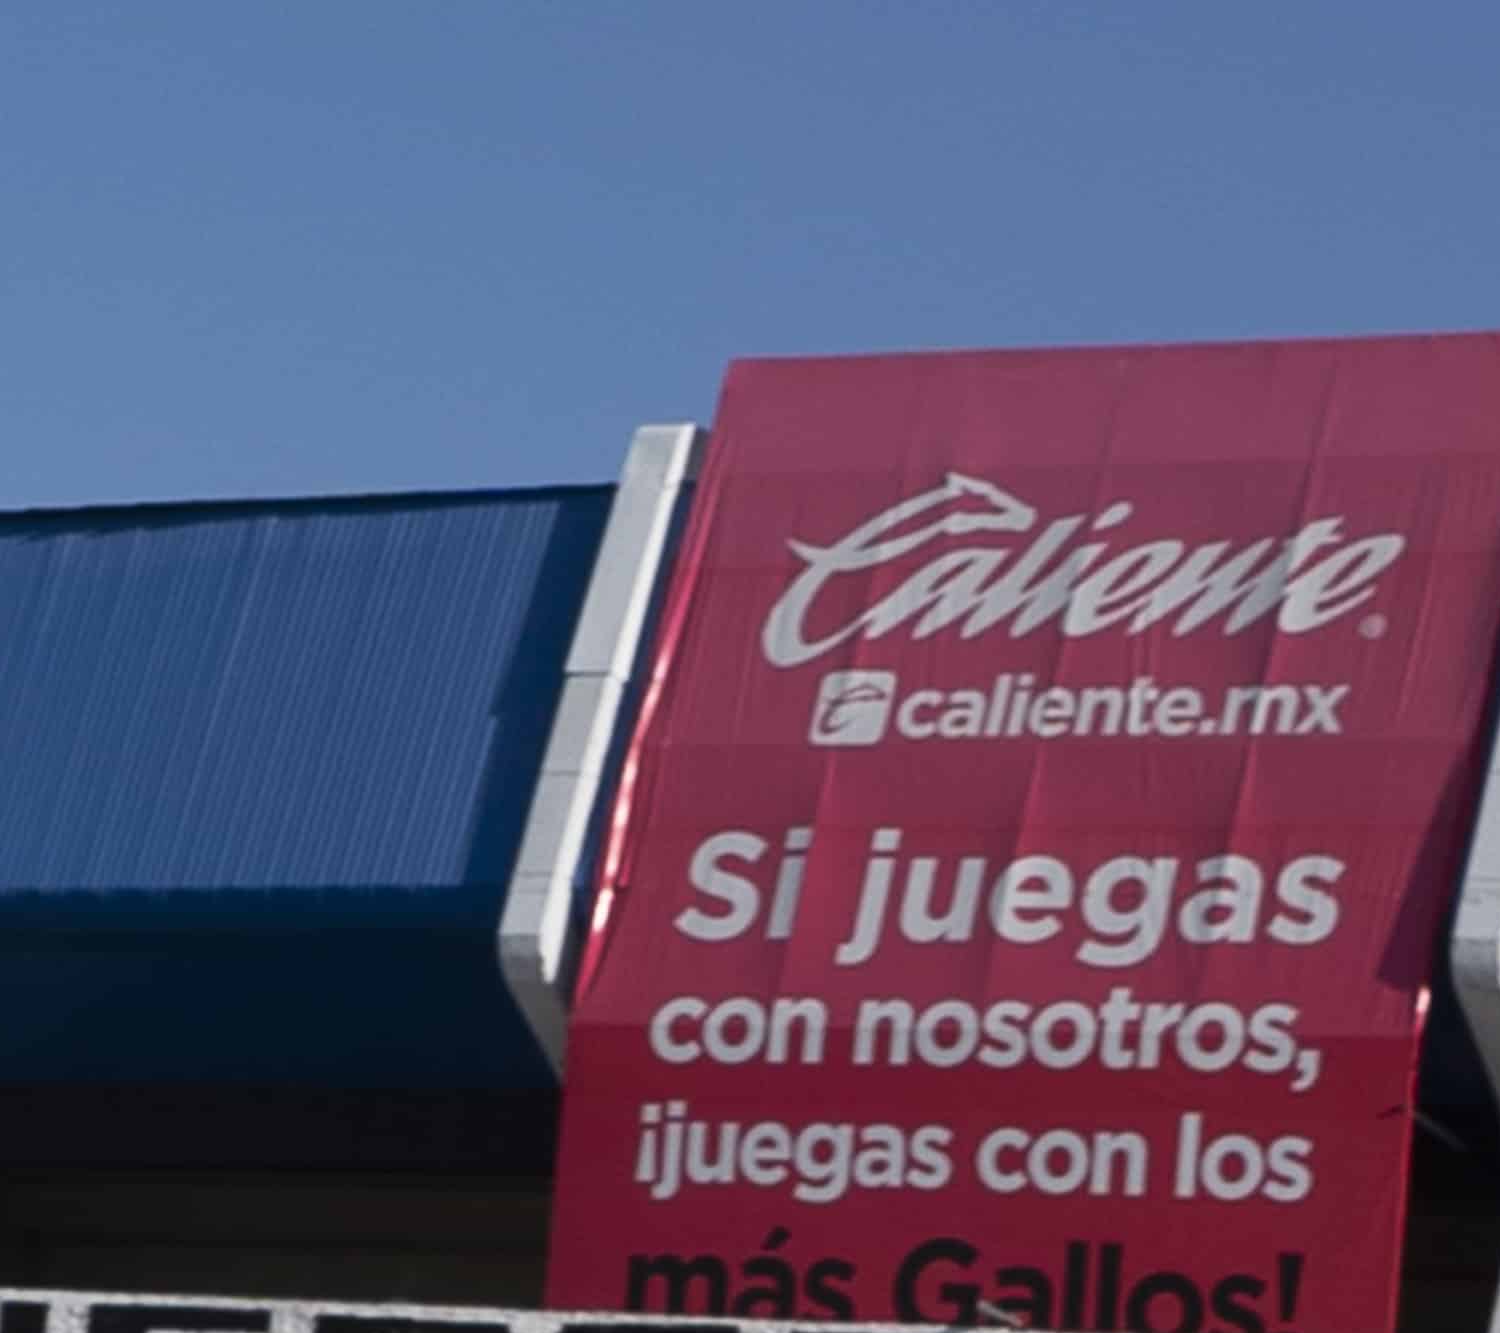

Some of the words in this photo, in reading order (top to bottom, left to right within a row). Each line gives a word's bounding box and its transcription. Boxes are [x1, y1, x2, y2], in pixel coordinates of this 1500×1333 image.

[763, 472, 1405, 667] Caliente
[896, 673, 1350, 740] caliente.mx
[674, 828, 812, 942] Si
[834, 828, 1346, 967] juegas
[649, 996, 827, 1064] con
[850, 988, 1320, 1091] nosotros,
[634, 1100, 952, 1203] ¡juegas
[976, 1124, 1148, 1197] con
[1174, 1112, 1314, 1201] los
[625, 1227, 857, 1322] más
